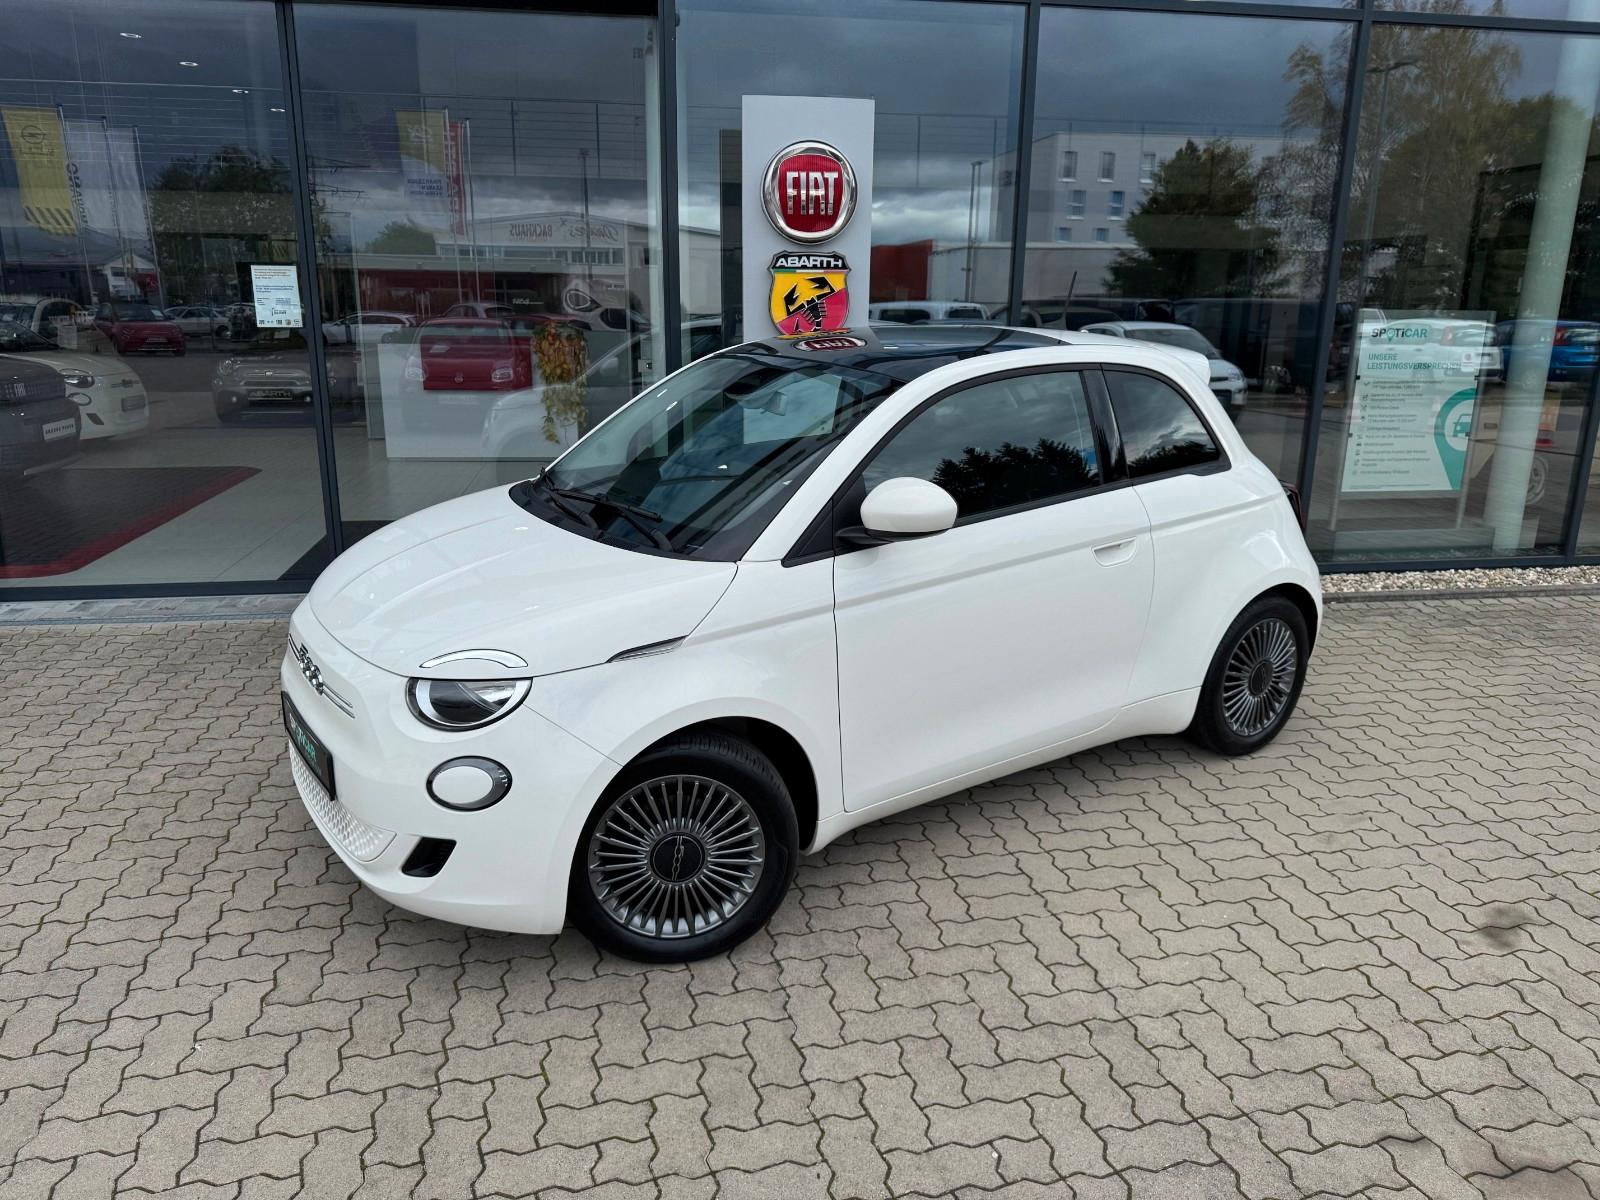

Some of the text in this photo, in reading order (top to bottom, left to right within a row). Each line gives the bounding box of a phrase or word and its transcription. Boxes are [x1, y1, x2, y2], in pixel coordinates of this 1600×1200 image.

[786, 171, 839, 216] FIAT
[776, 256, 842, 268] ABARTH
[1368, 353, 1399, 361] UNSERE
